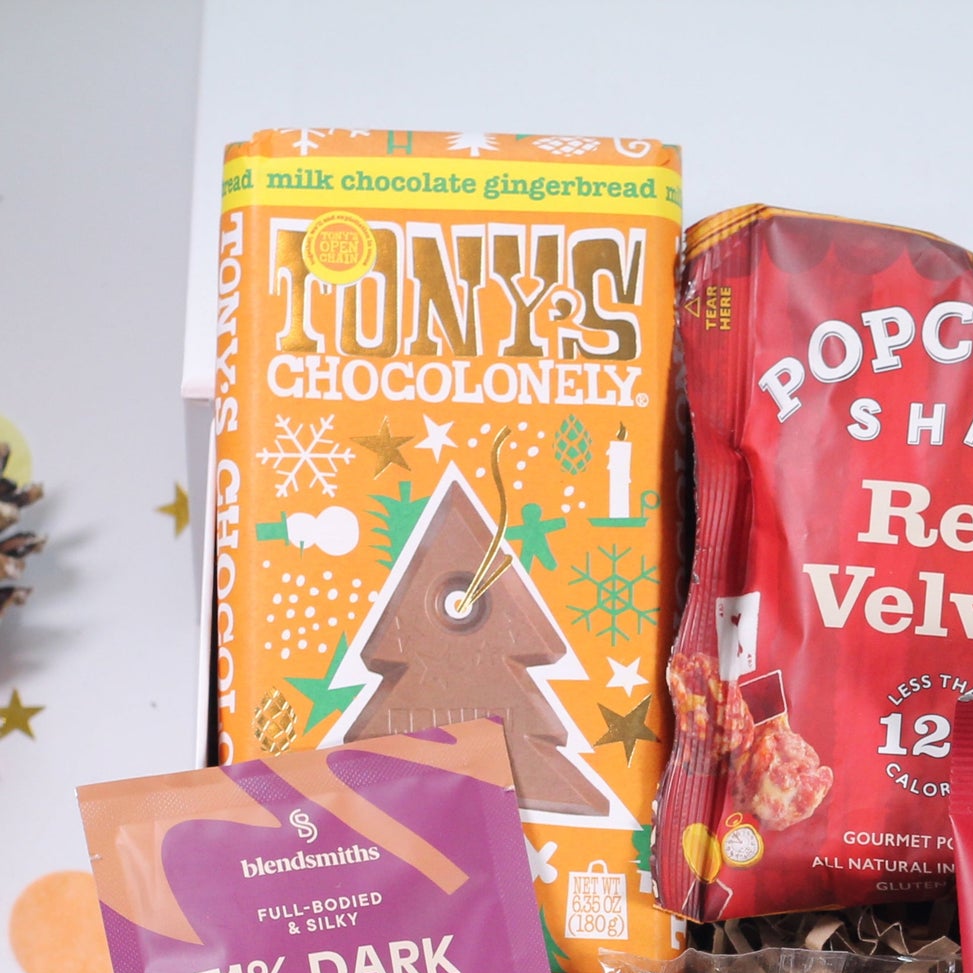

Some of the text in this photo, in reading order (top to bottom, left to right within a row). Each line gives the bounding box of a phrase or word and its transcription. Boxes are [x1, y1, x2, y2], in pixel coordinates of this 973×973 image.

[266, 168, 658, 200] milk chocolate gingerbread
[319, 240, 359, 253] OPEN
[320, 231, 359, 241] TONY'S
[319, 253, 359, 264] CHAIN
[269, 217, 647, 361] TONY'S
[706, 286, 717, 330] TEAR
[720, 287, 731, 330] HERE
[215, 211, 244, 436] TONY'S
[888, 675, 932, 705] LESS
[878, 712, 951, 758] 12
[843, 831, 931, 849] GOURMET
[240, 844, 380, 878] blendsmiths
[812, 856, 843, 869] ALL
[849, 858, 932, 874] NATURAL
[573, 876, 621, 895] NET WT
[257, 891, 383, 922] FULL-BODIED
[572, 895, 622, 914] 6.35 OZ
[288, 912, 358, 935] & SILKY
